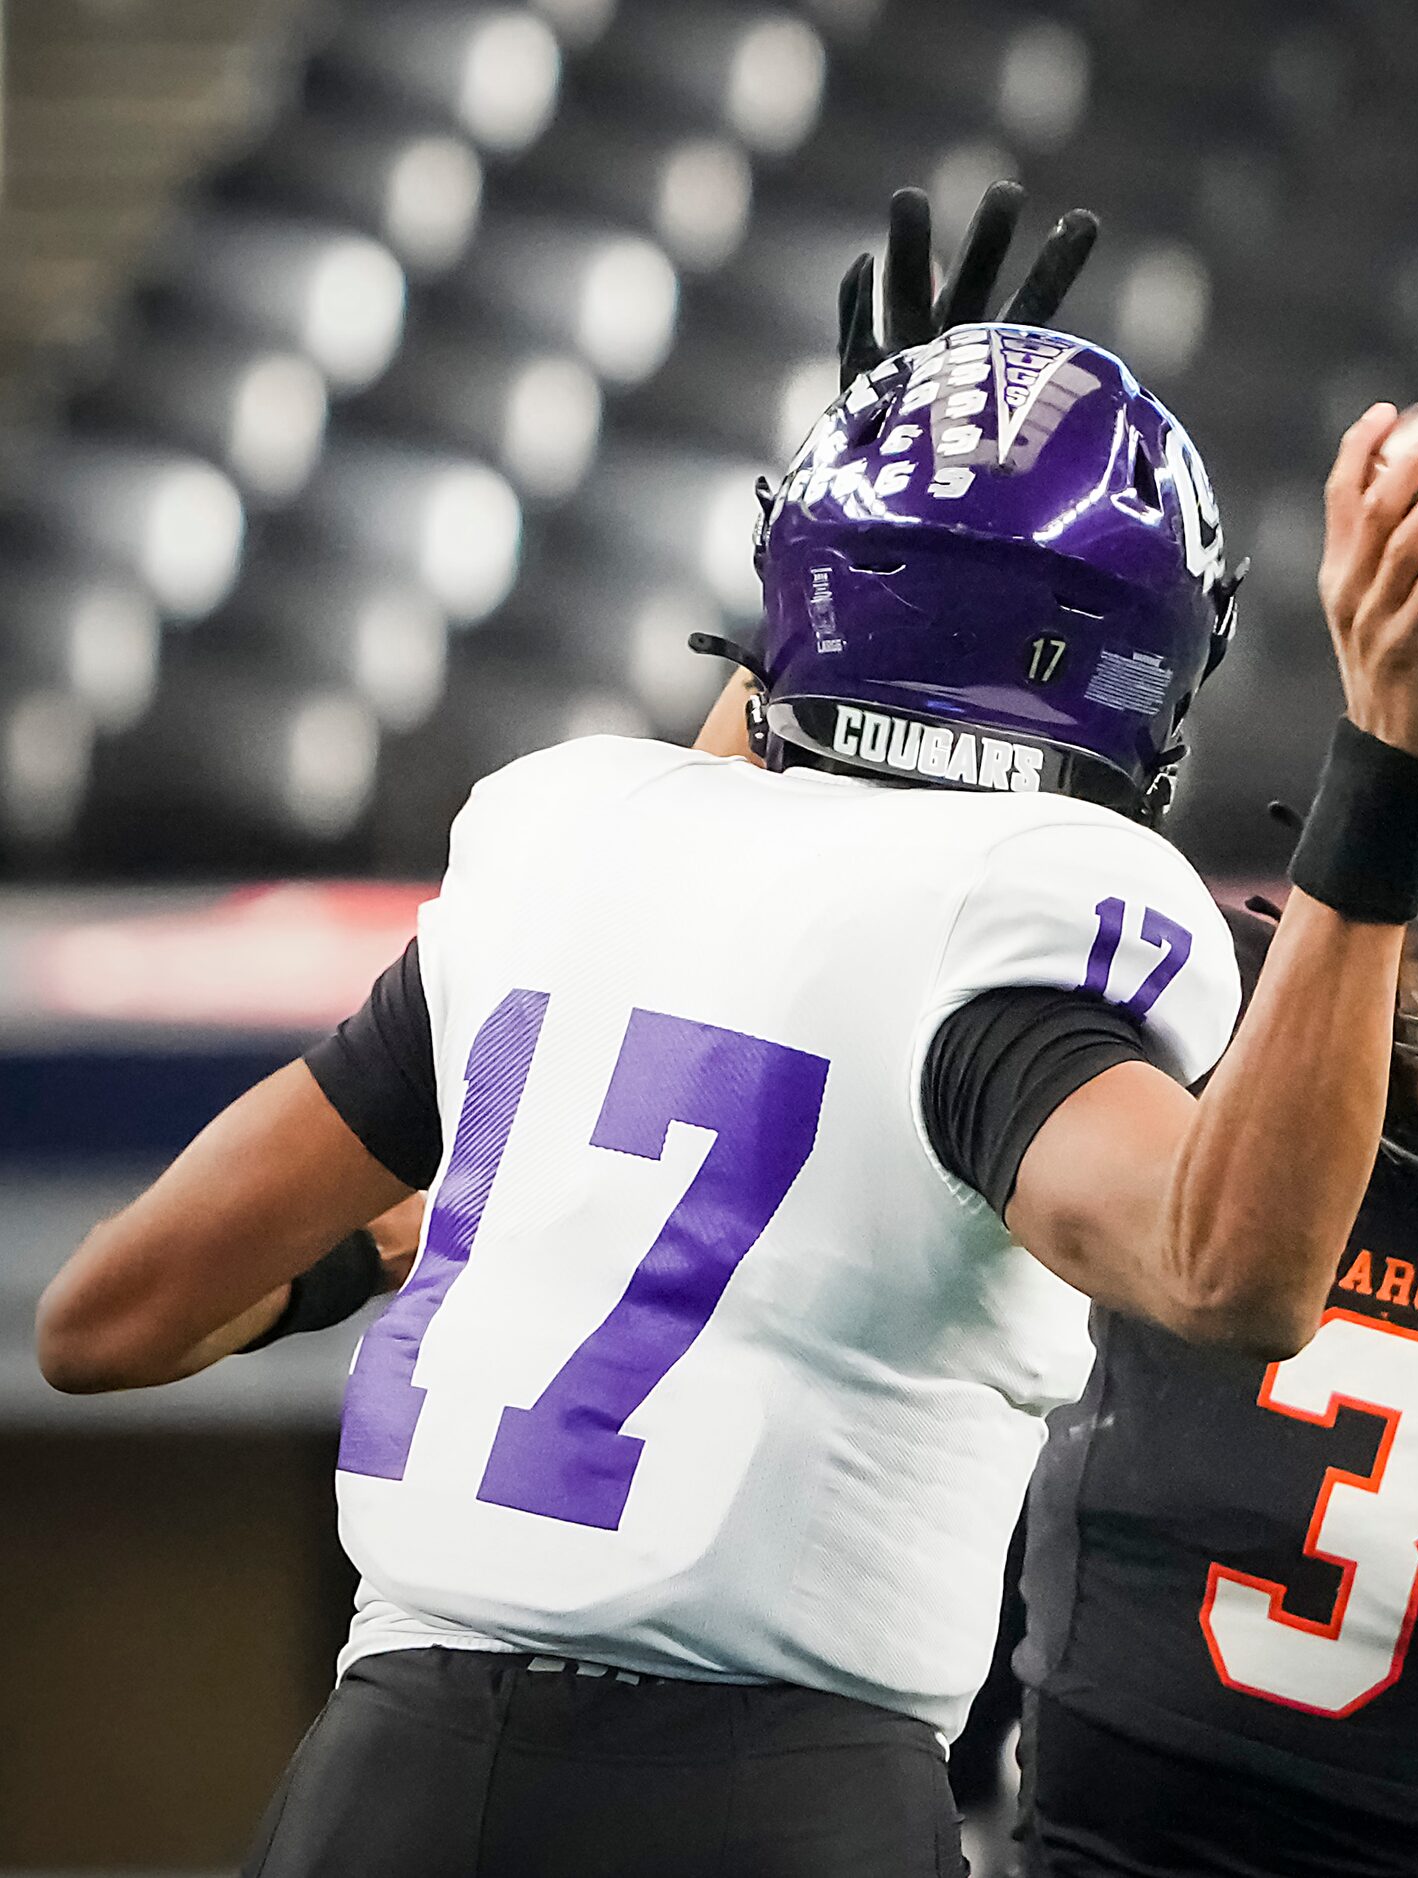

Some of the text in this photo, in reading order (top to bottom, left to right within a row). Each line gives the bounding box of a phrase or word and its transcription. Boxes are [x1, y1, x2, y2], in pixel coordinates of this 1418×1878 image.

[1028, 637, 1067, 682] 17
[833, 704, 1045, 793] COUGARS
[1073, 895, 1193, 1025] 17
[337, 987, 831, 1531] 17
